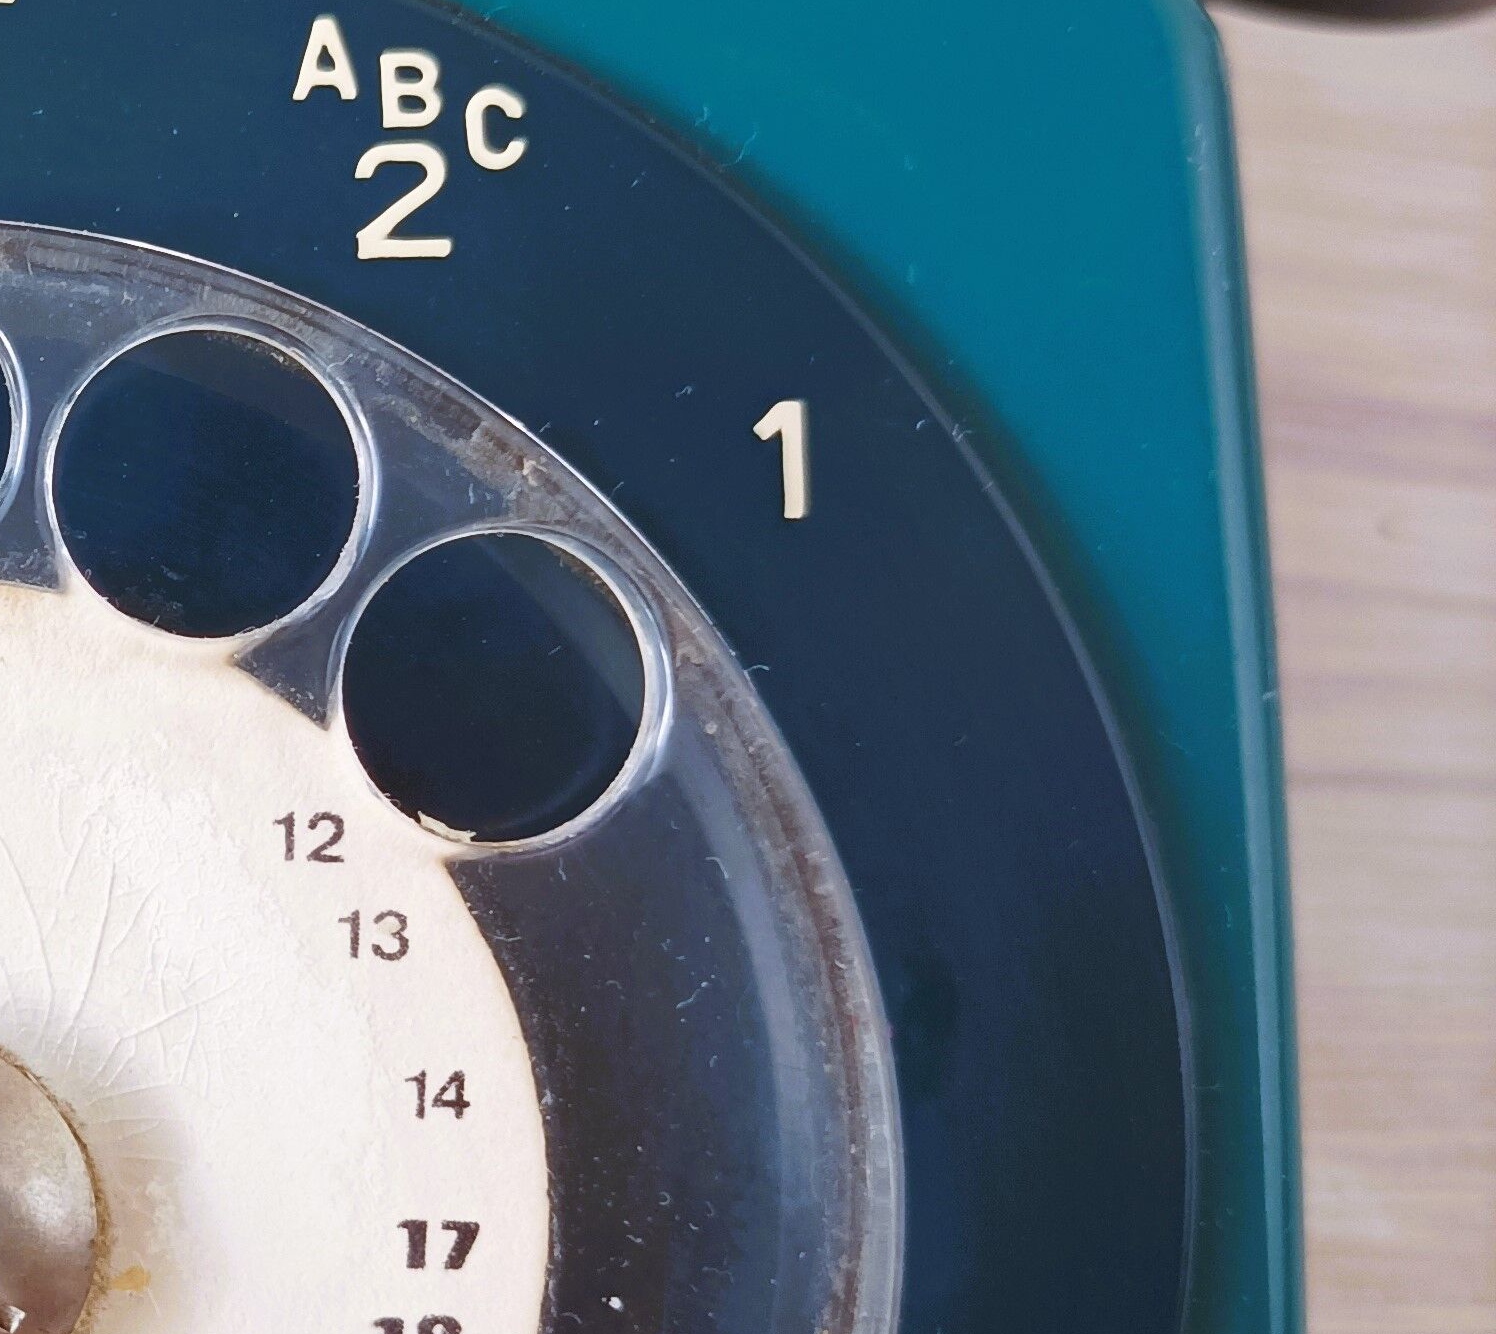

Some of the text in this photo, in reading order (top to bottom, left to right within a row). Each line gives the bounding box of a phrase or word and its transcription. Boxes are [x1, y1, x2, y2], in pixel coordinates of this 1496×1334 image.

[292, 14, 528, 171] ABC
[354, 140, 453, 260] 2
[752, 399, 810, 520] 1
[273, 810, 345, 863] 12
[338, 909, 410, 962] 13
[405, 1069, 471, 1120] 14
[397, 1219, 481, 1270] 17
